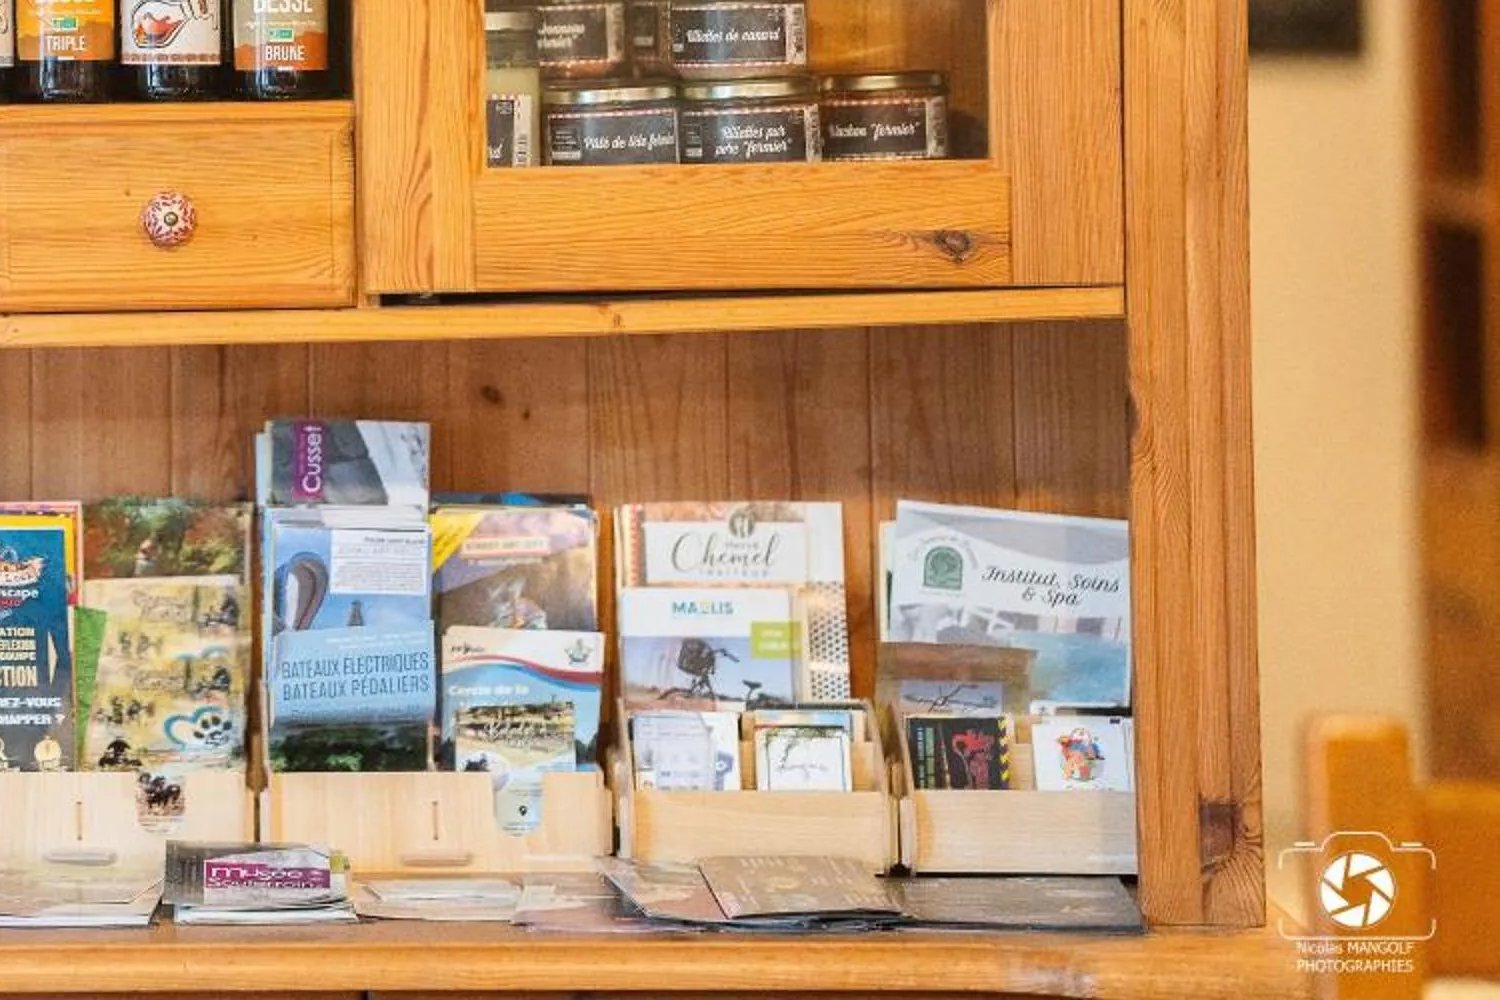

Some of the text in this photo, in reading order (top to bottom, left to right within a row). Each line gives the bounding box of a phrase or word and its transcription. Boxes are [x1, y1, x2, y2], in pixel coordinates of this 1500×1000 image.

[46, 36, 85, 52] TRIPLE
[725, 28, 739, 42] de
[265, 45, 305, 61] BRUNE
[302, 425, 322, 493] Cusset
[1068, 572, 1120, 593] Soins
[1021, 586, 1080, 608] & Spa
[281, 659, 340, 680] BATEAUX
[283, 675, 429, 701] BATEAUX PÉDALIERS
[55, 714, 65, 726] ?
